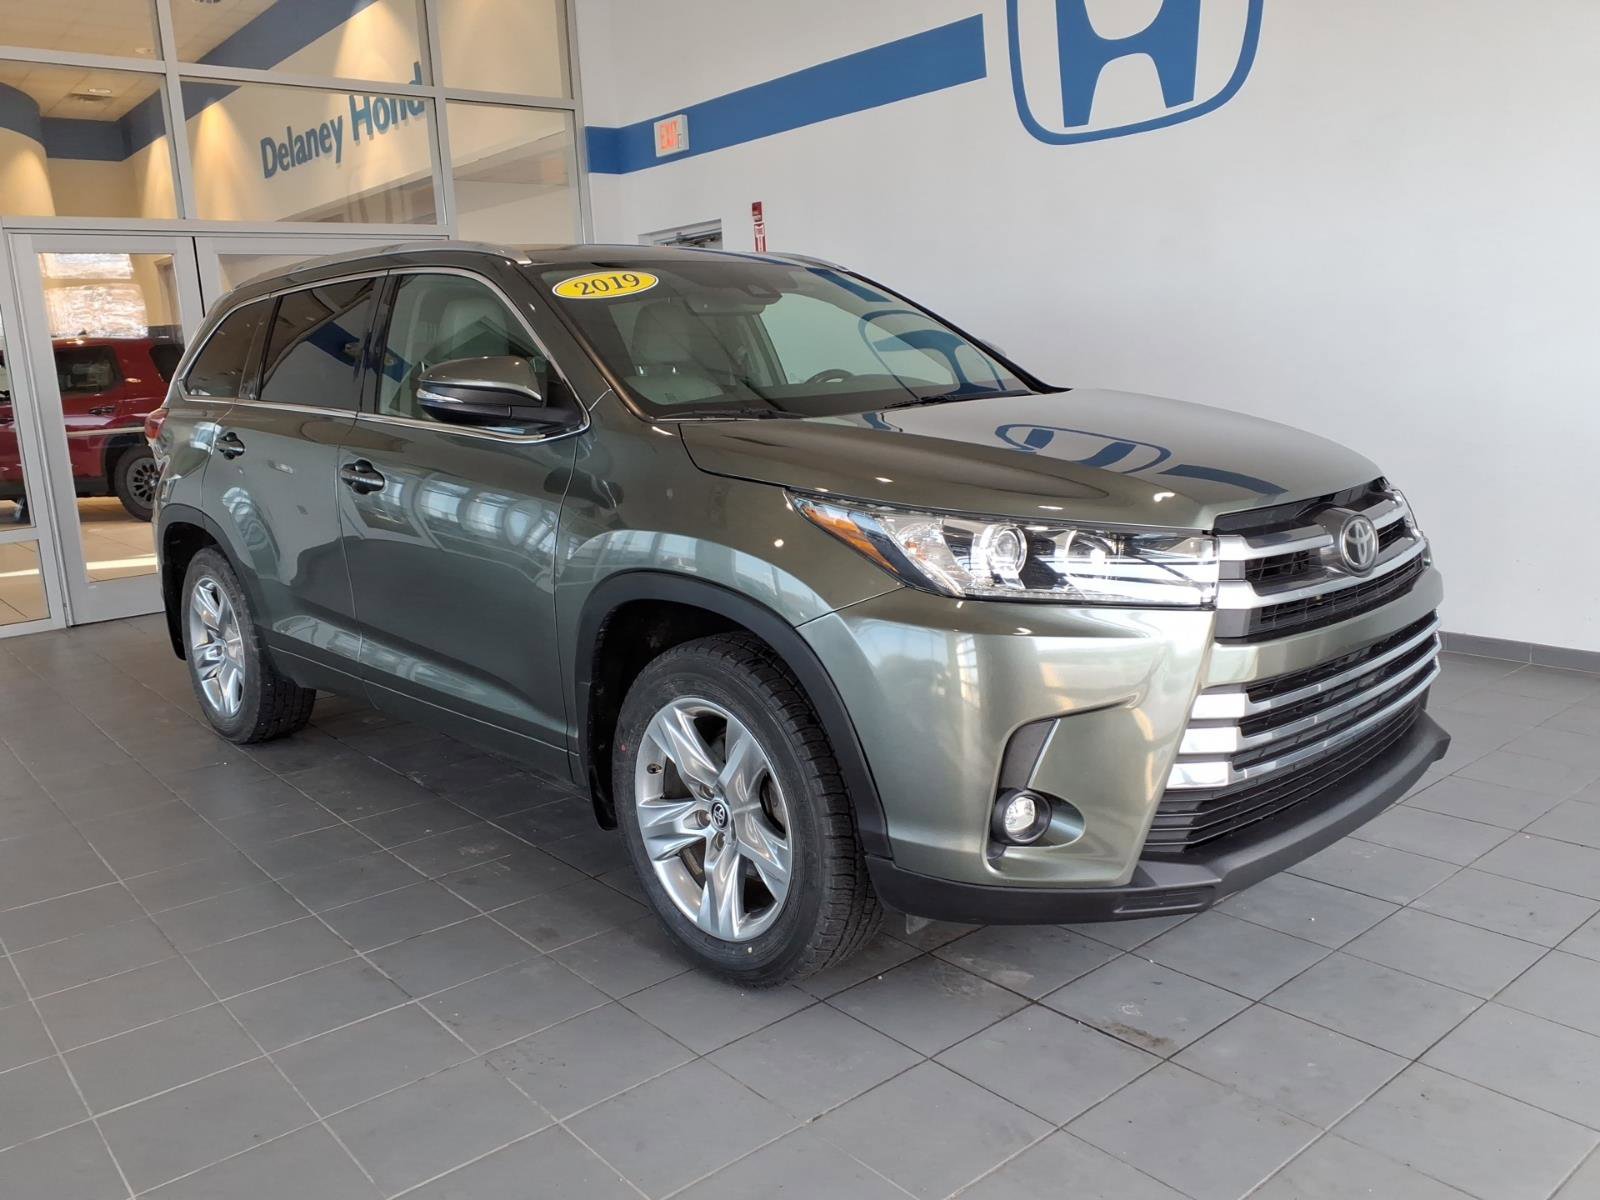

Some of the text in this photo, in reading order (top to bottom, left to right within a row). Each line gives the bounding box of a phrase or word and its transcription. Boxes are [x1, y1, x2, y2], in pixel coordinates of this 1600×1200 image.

[260, 61, 425, 179] Delaney Hond
[574, 273, 640, 295] 2019
